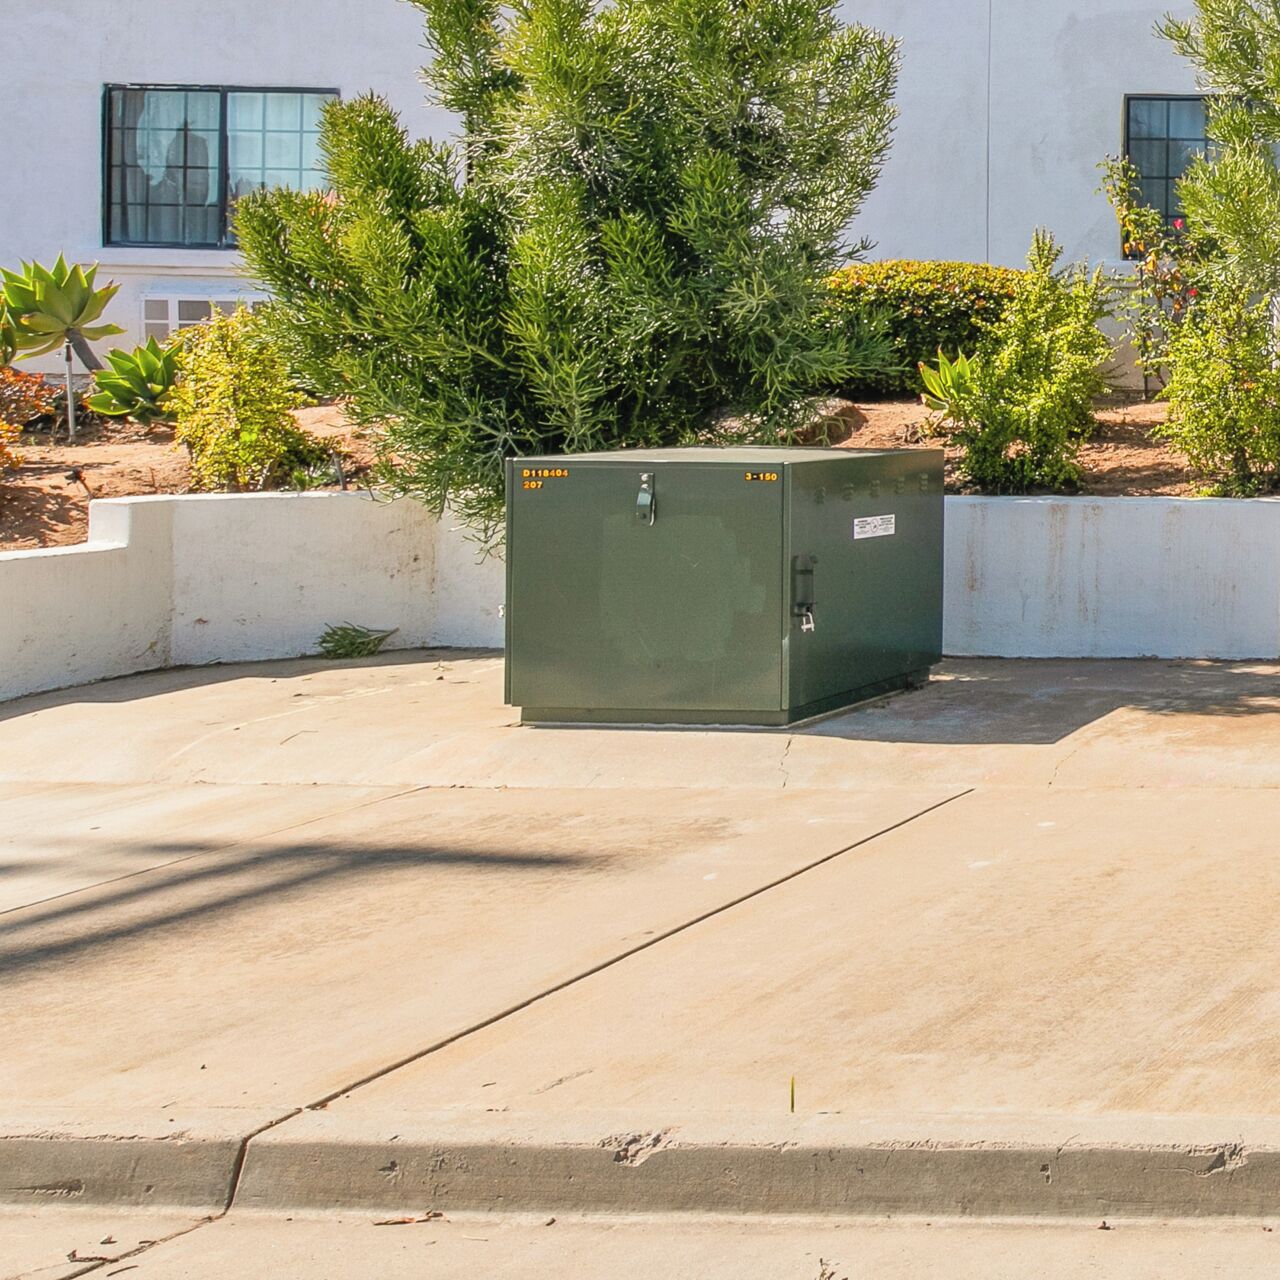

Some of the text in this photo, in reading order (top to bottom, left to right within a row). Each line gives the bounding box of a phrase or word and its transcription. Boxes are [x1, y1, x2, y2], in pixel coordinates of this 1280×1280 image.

[523, 469, 568, 477] D118404
[745, 472, 777, 481] 3-150
[523, 480, 543, 489] 207
